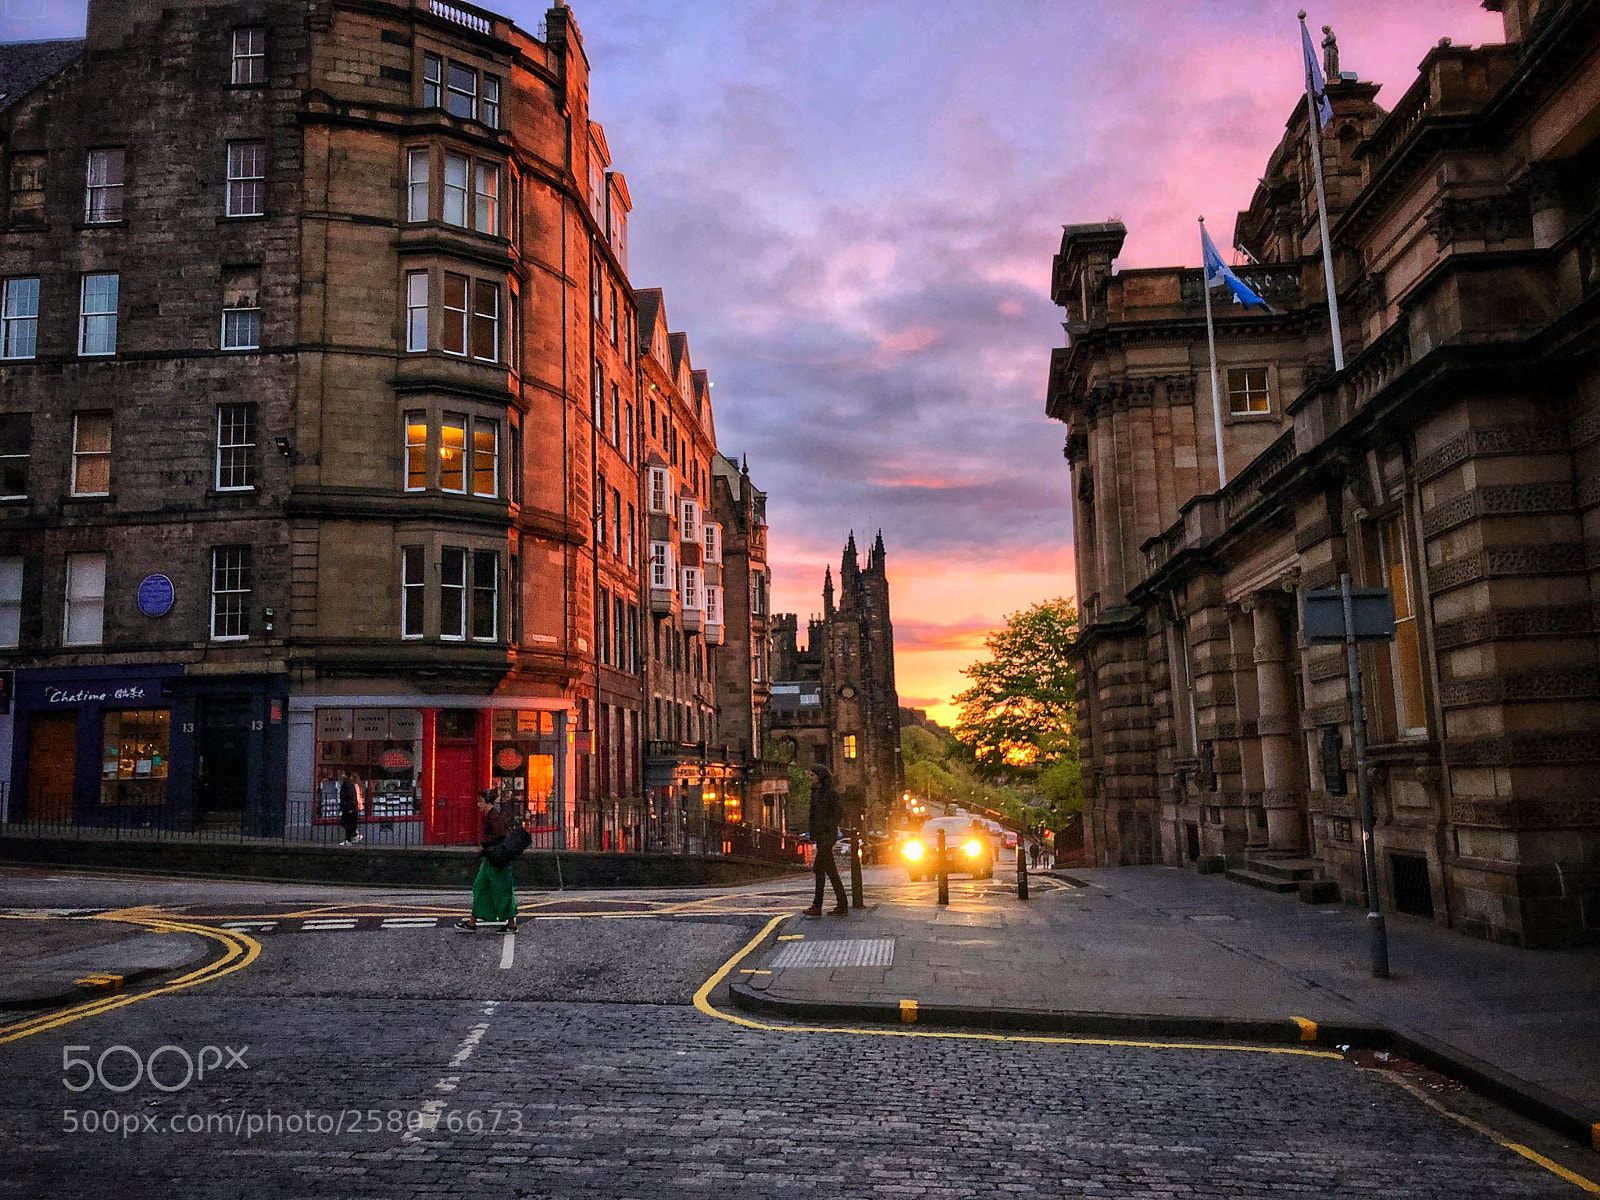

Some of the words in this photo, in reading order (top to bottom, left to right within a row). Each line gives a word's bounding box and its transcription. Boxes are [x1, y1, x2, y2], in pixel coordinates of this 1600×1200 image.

[50, 690, 106, 702] Chatime
[182, 723, 195, 733] 13
[252, 720, 264, 731] 13
